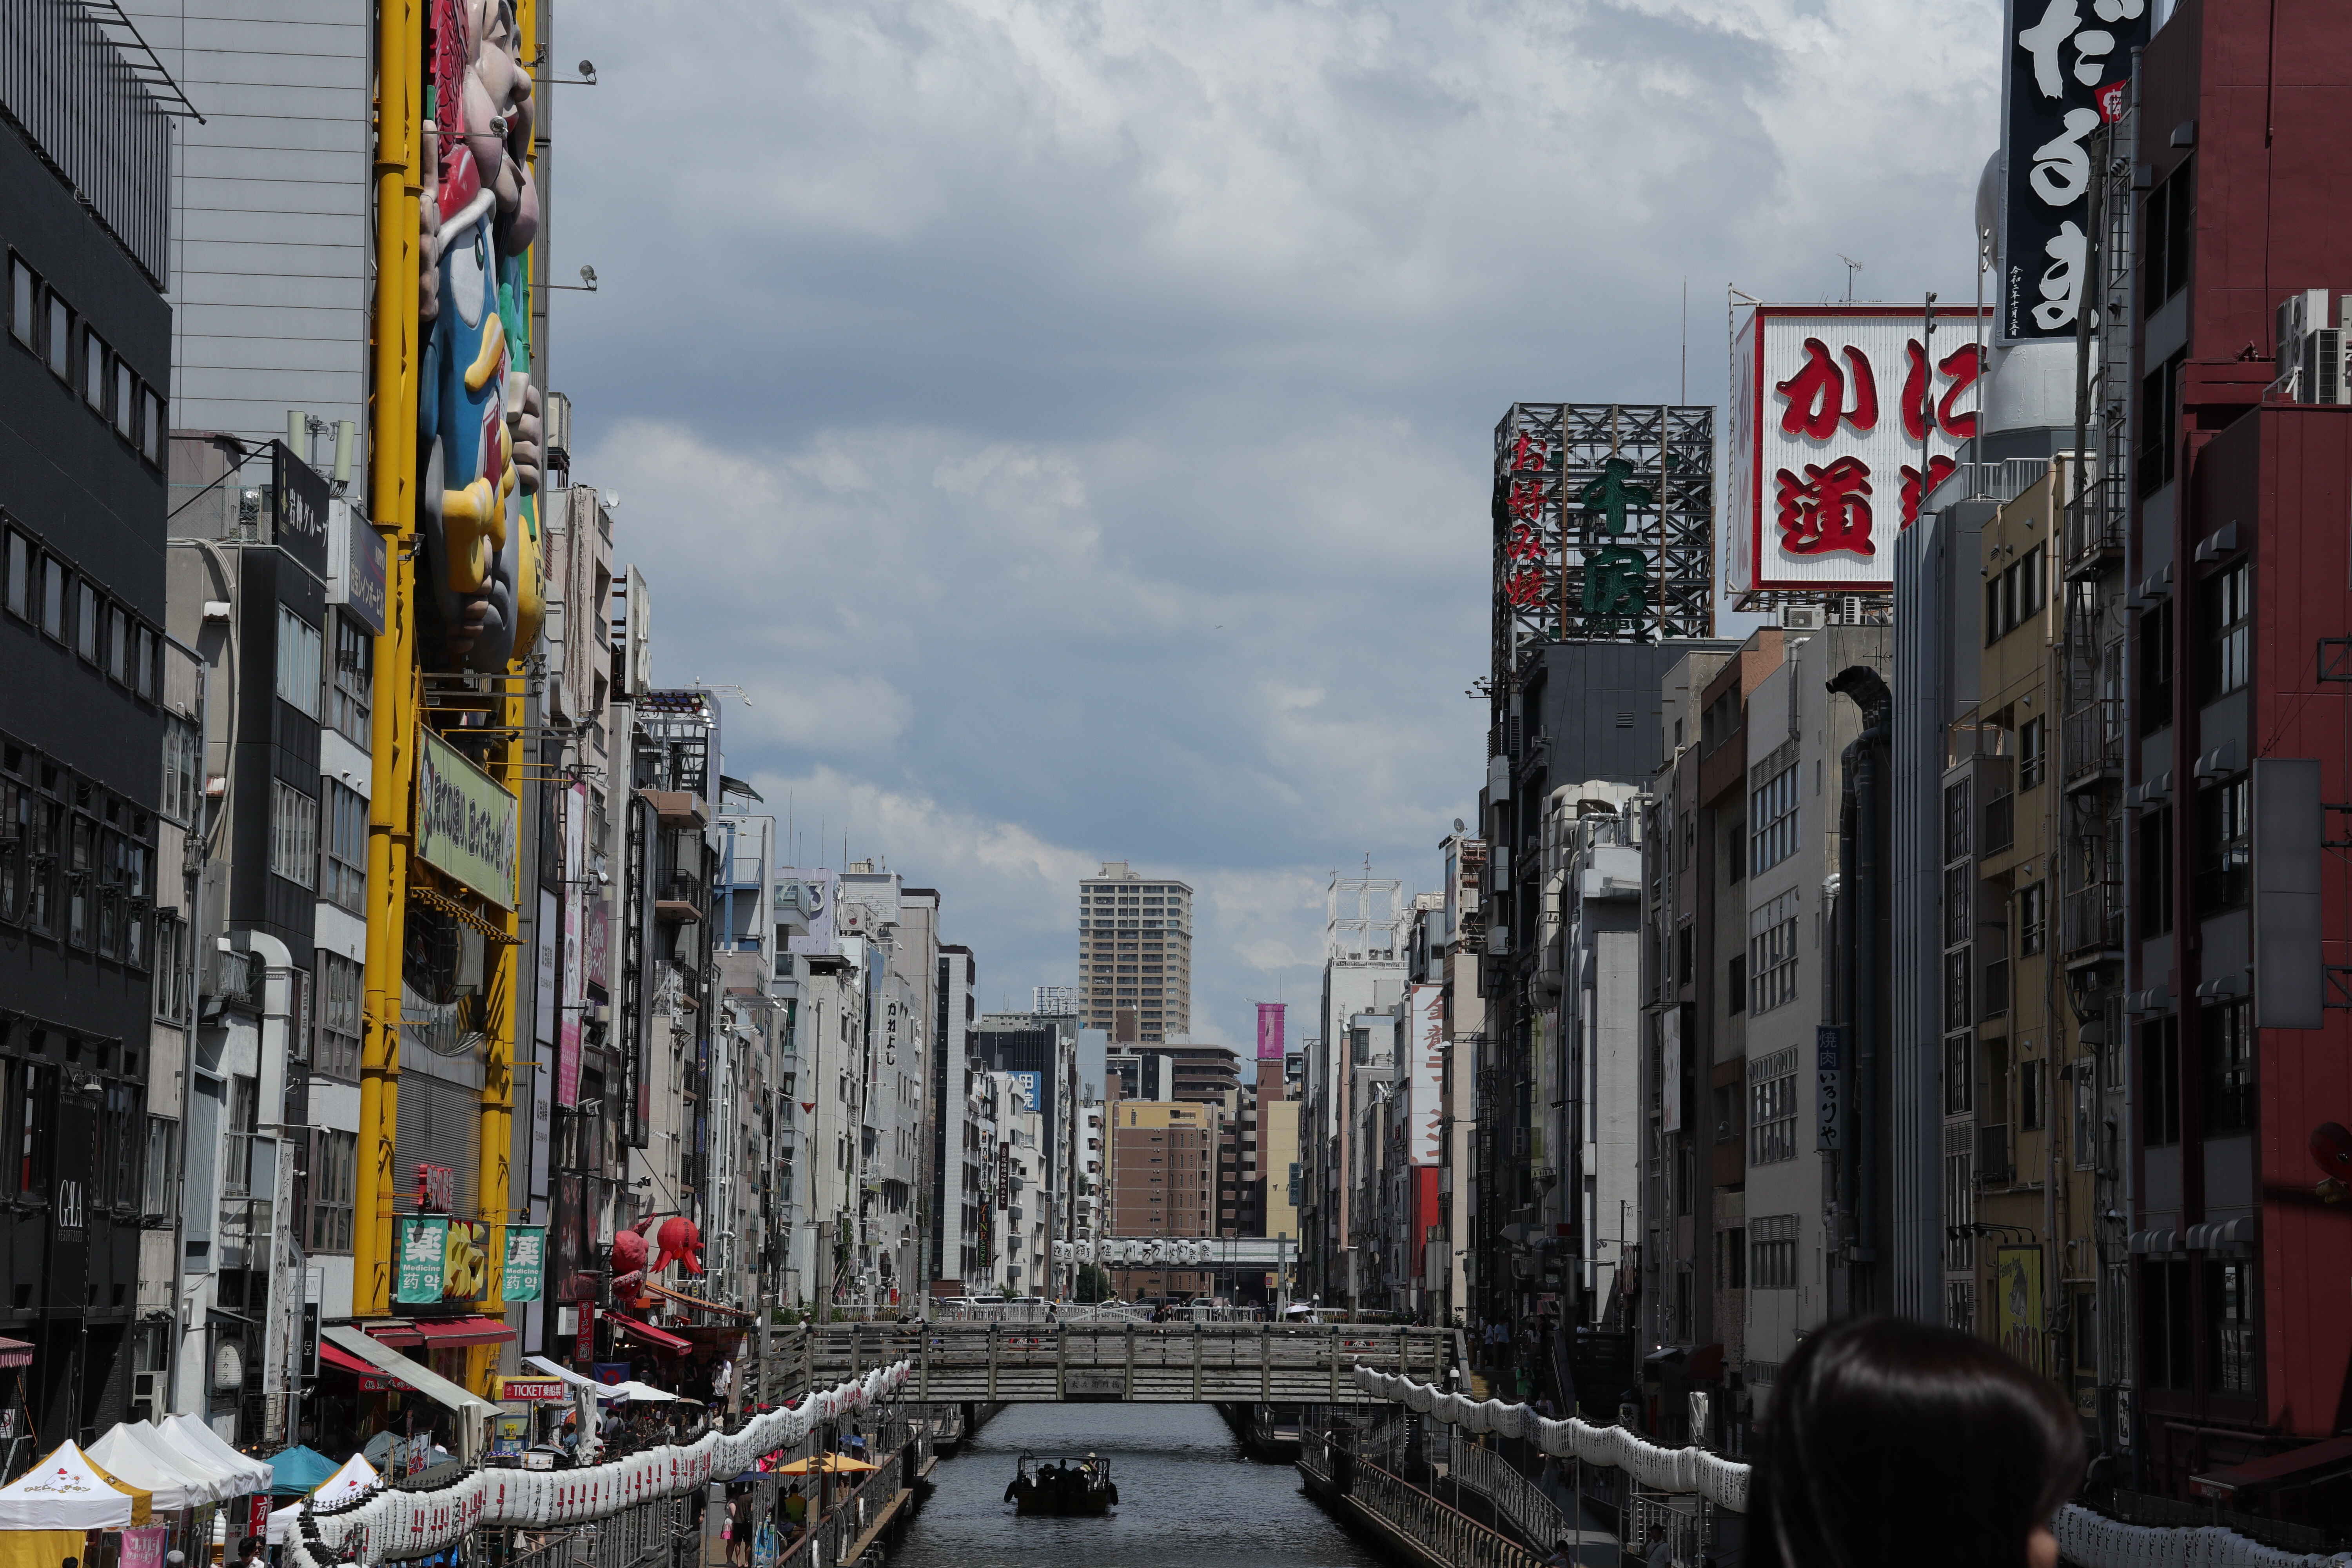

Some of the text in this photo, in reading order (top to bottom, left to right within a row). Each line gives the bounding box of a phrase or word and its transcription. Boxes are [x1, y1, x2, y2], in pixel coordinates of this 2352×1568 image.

[1776, 337, 1987, 441] かに
[1505, 431, 1549, 607] お好み焼
[1581, 458, 1653, 614] 千房
[1819, 1030, 1837, 1068] 焼肉
[1820, 1073, 1837, 1147] いろりや
[59, 1179, 83, 1227] GALA
[979, 1204, 988, 1240] FINE
[405, 1226, 442, 1262] 薬
[508, 1235, 540, 1266] 薬
[403, 1274, 419, 1290] 药
[424, 1274, 441, 1290] 약
[506, 1276, 520, 1290] 药
[525, 1277, 538, 1291] 약
[577, 1302, 590, 1360] ラーメン一蘭
[514, 1385, 562, 1397] TICKET 乗船票
